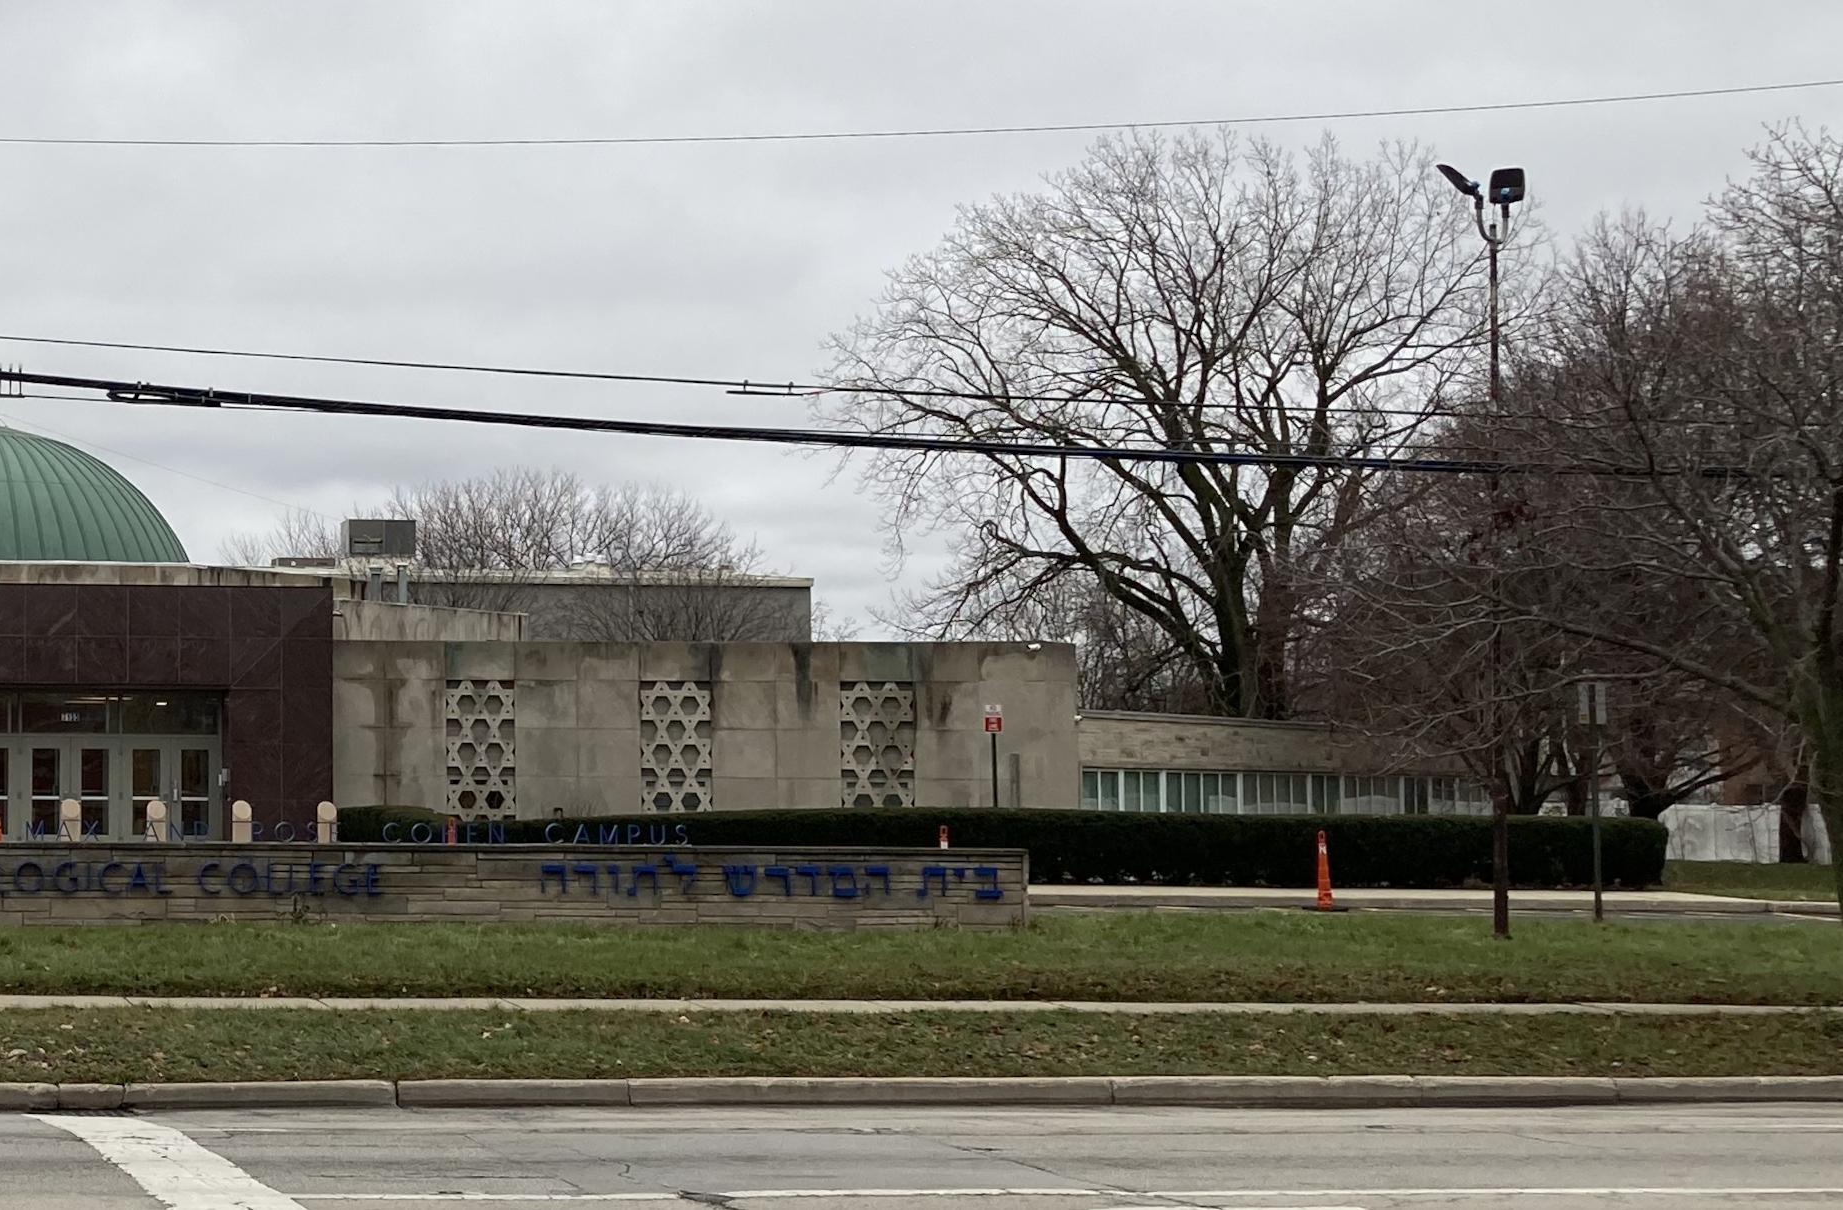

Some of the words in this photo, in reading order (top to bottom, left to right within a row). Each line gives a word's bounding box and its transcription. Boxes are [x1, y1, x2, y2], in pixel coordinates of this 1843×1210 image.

[25, 819, 100, 842] MAX
[142, 819, 210, 842] AND
[382, 822, 507, 845] COHEN
[545, 822, 688, 846] CAMPUS
[198, 861, 383, 896] COLLEGE
[540, 852, 698, 897] לתורה
[722, 864, 891, 899] המדרש
[917, 865, 1004, 899] בית
